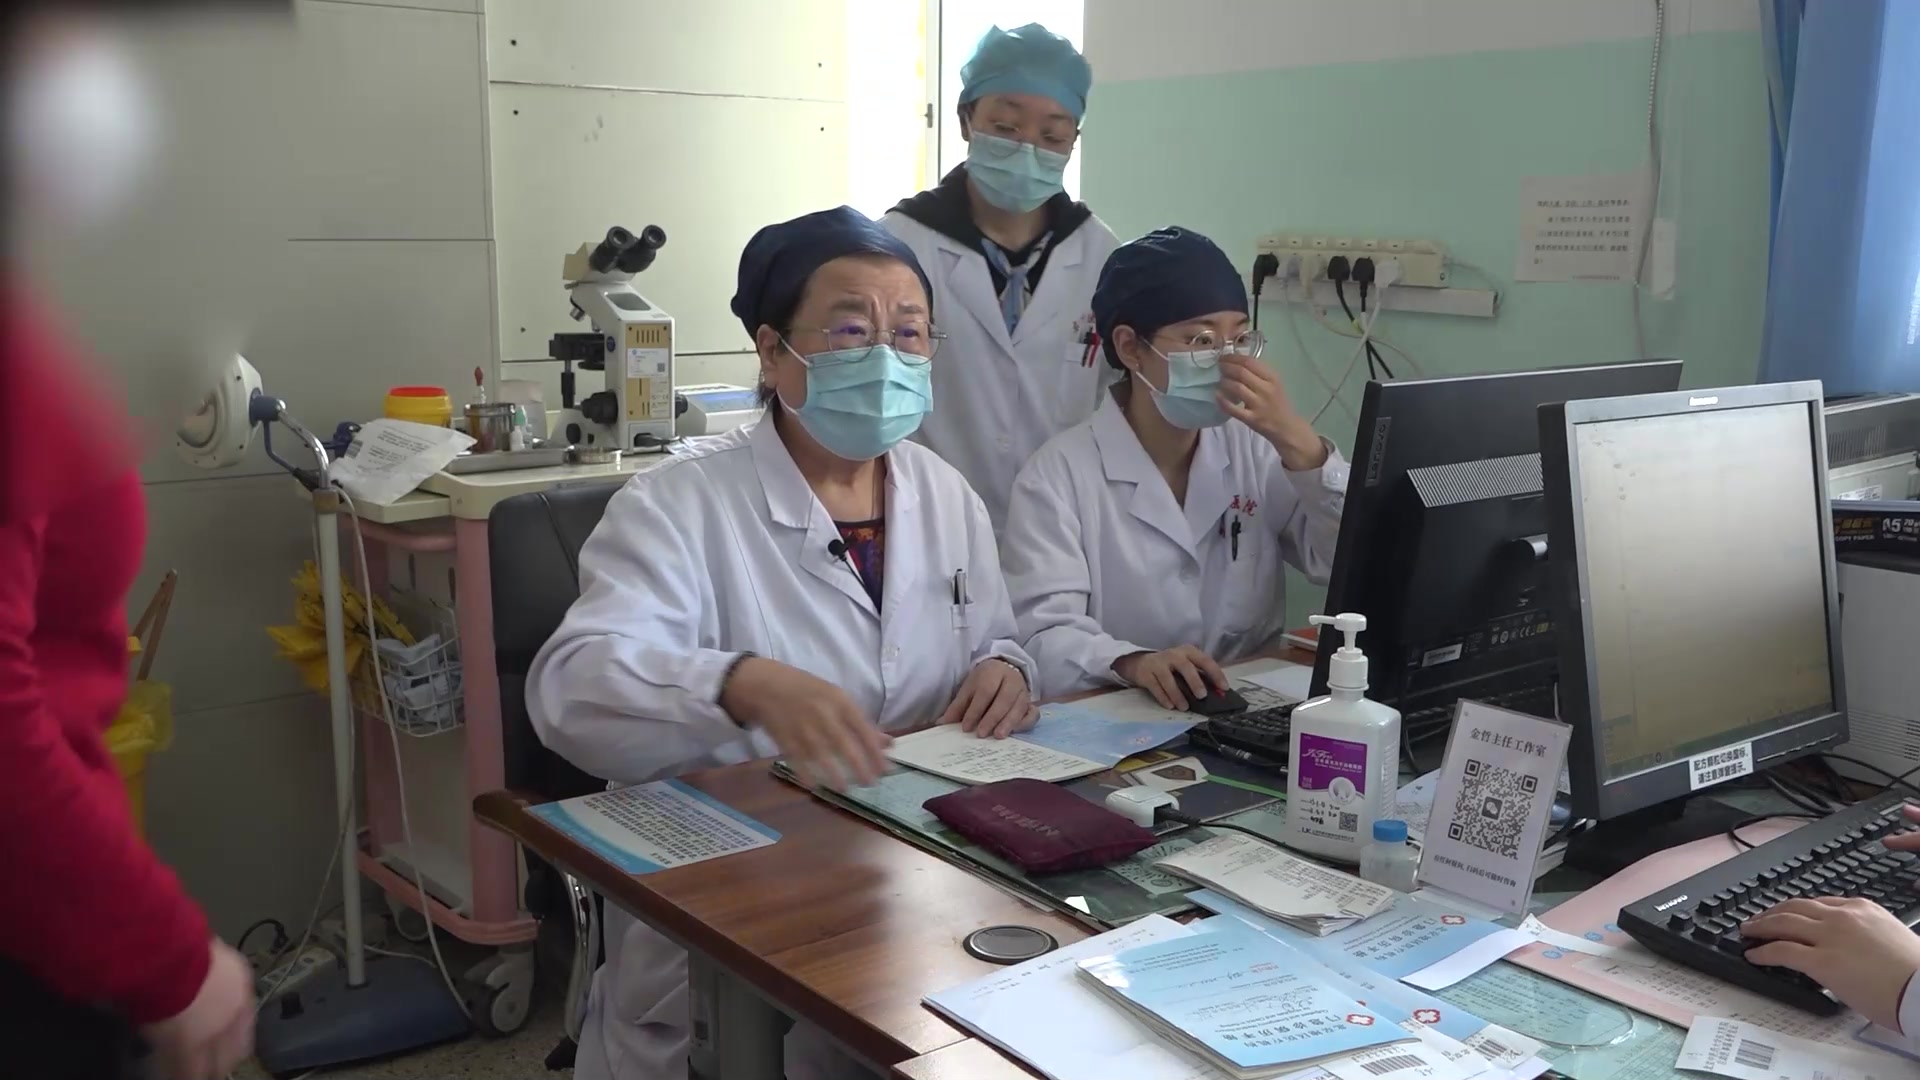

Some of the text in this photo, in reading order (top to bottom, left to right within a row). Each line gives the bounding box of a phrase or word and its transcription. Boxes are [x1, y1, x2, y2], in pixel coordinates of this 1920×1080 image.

[1367, 423, 1386, 480] Lenovo
[1470, 727, 1547, 758] 金哲主任工作室
[1652, 894, 1688, 912] lenovo
